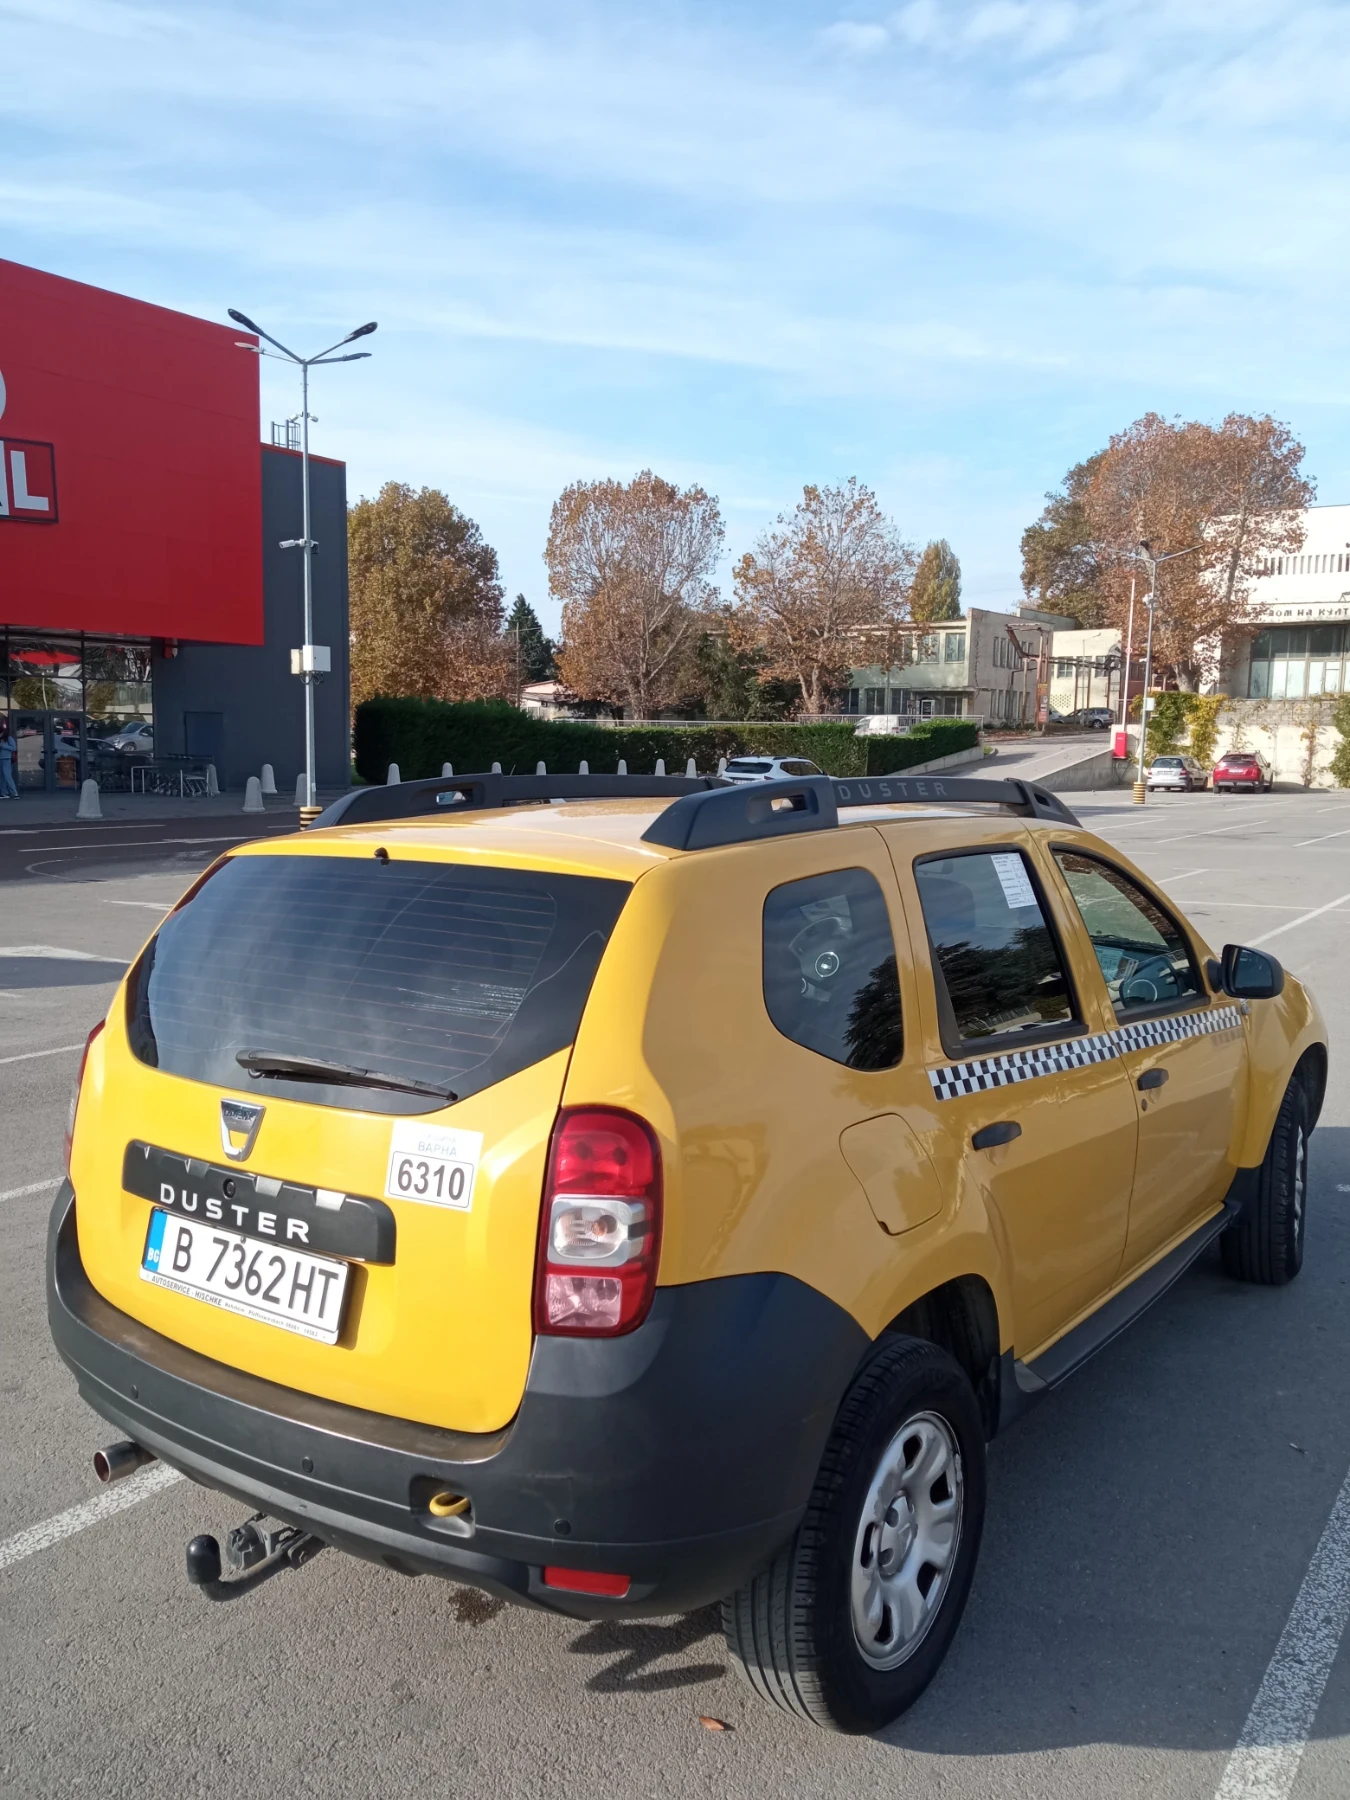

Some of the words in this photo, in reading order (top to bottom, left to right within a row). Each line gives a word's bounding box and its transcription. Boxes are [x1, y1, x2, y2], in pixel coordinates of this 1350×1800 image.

[837, 782, 948, 800] DUSTER
[417, 1141, 457, 1157] ВАРНА
[397, 1158, 465, 1201] 6310
[160, 1183, 310, 1244] DUSTER
[147, 1247, 160, 1263] BG
[151, 1275, 190, 1295] AUTOSERVICE
[194, 1290, 223, 1306] MISCHKE
